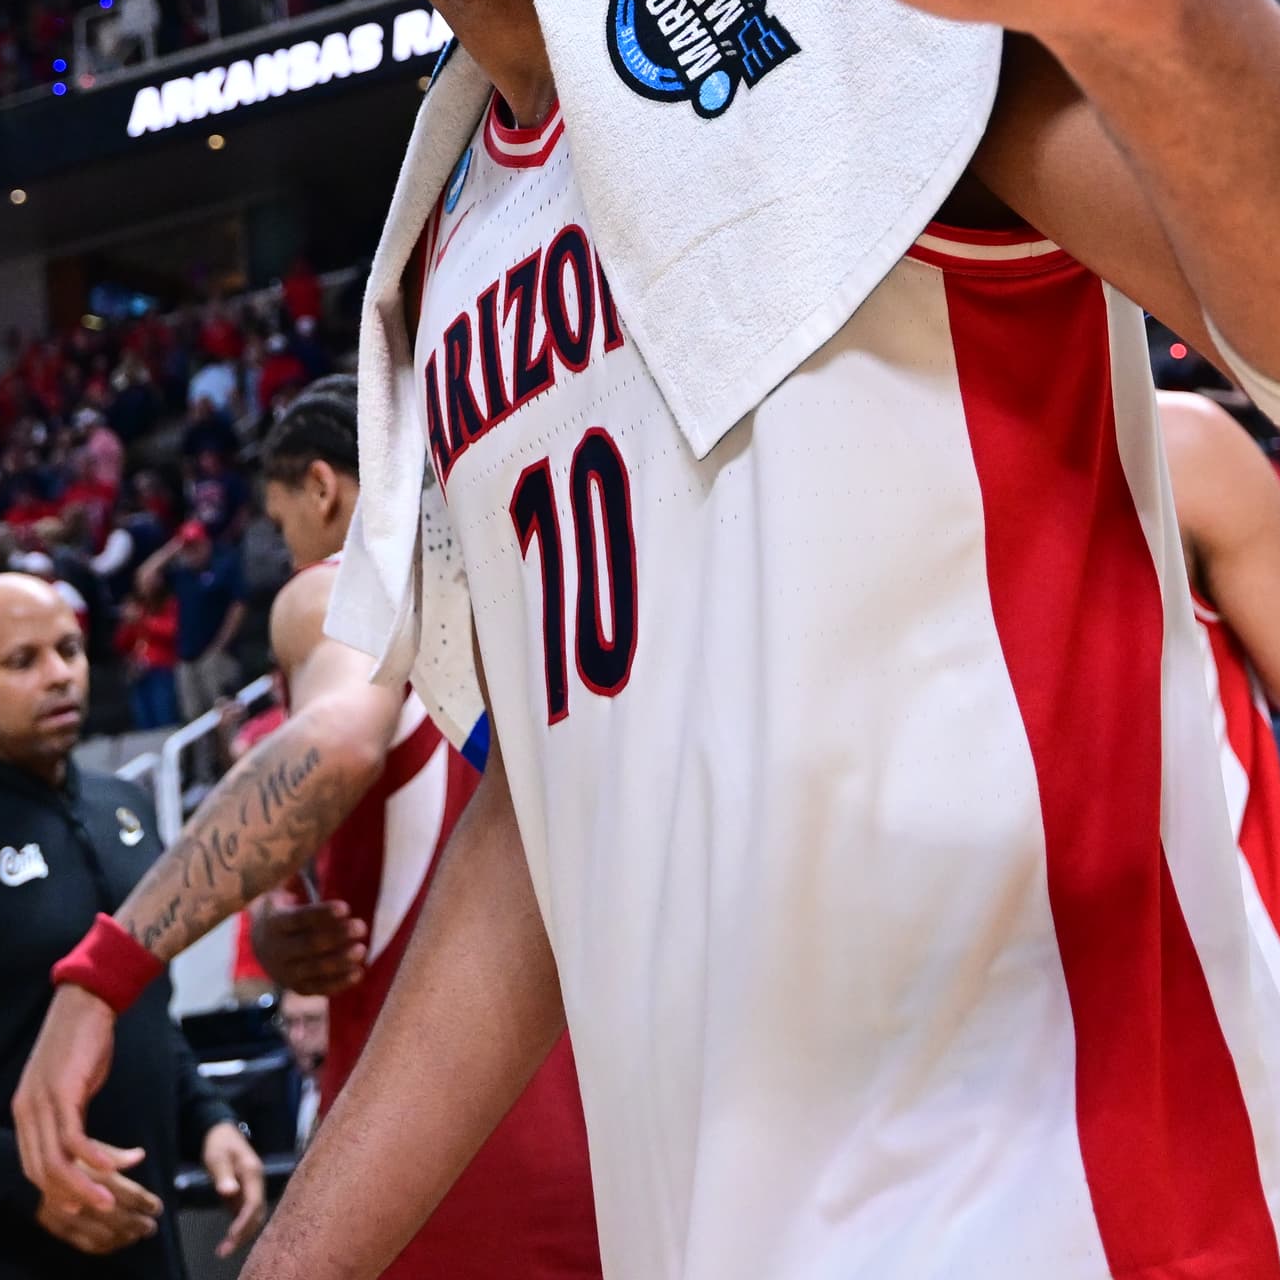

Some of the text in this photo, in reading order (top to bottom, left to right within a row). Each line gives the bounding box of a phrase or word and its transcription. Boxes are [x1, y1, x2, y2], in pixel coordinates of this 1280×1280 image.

[127, 22, 384, 137] ARKANSAS
[621, 28, 659, 82] SWEET 16
[509, 426, 639, 726] 10
